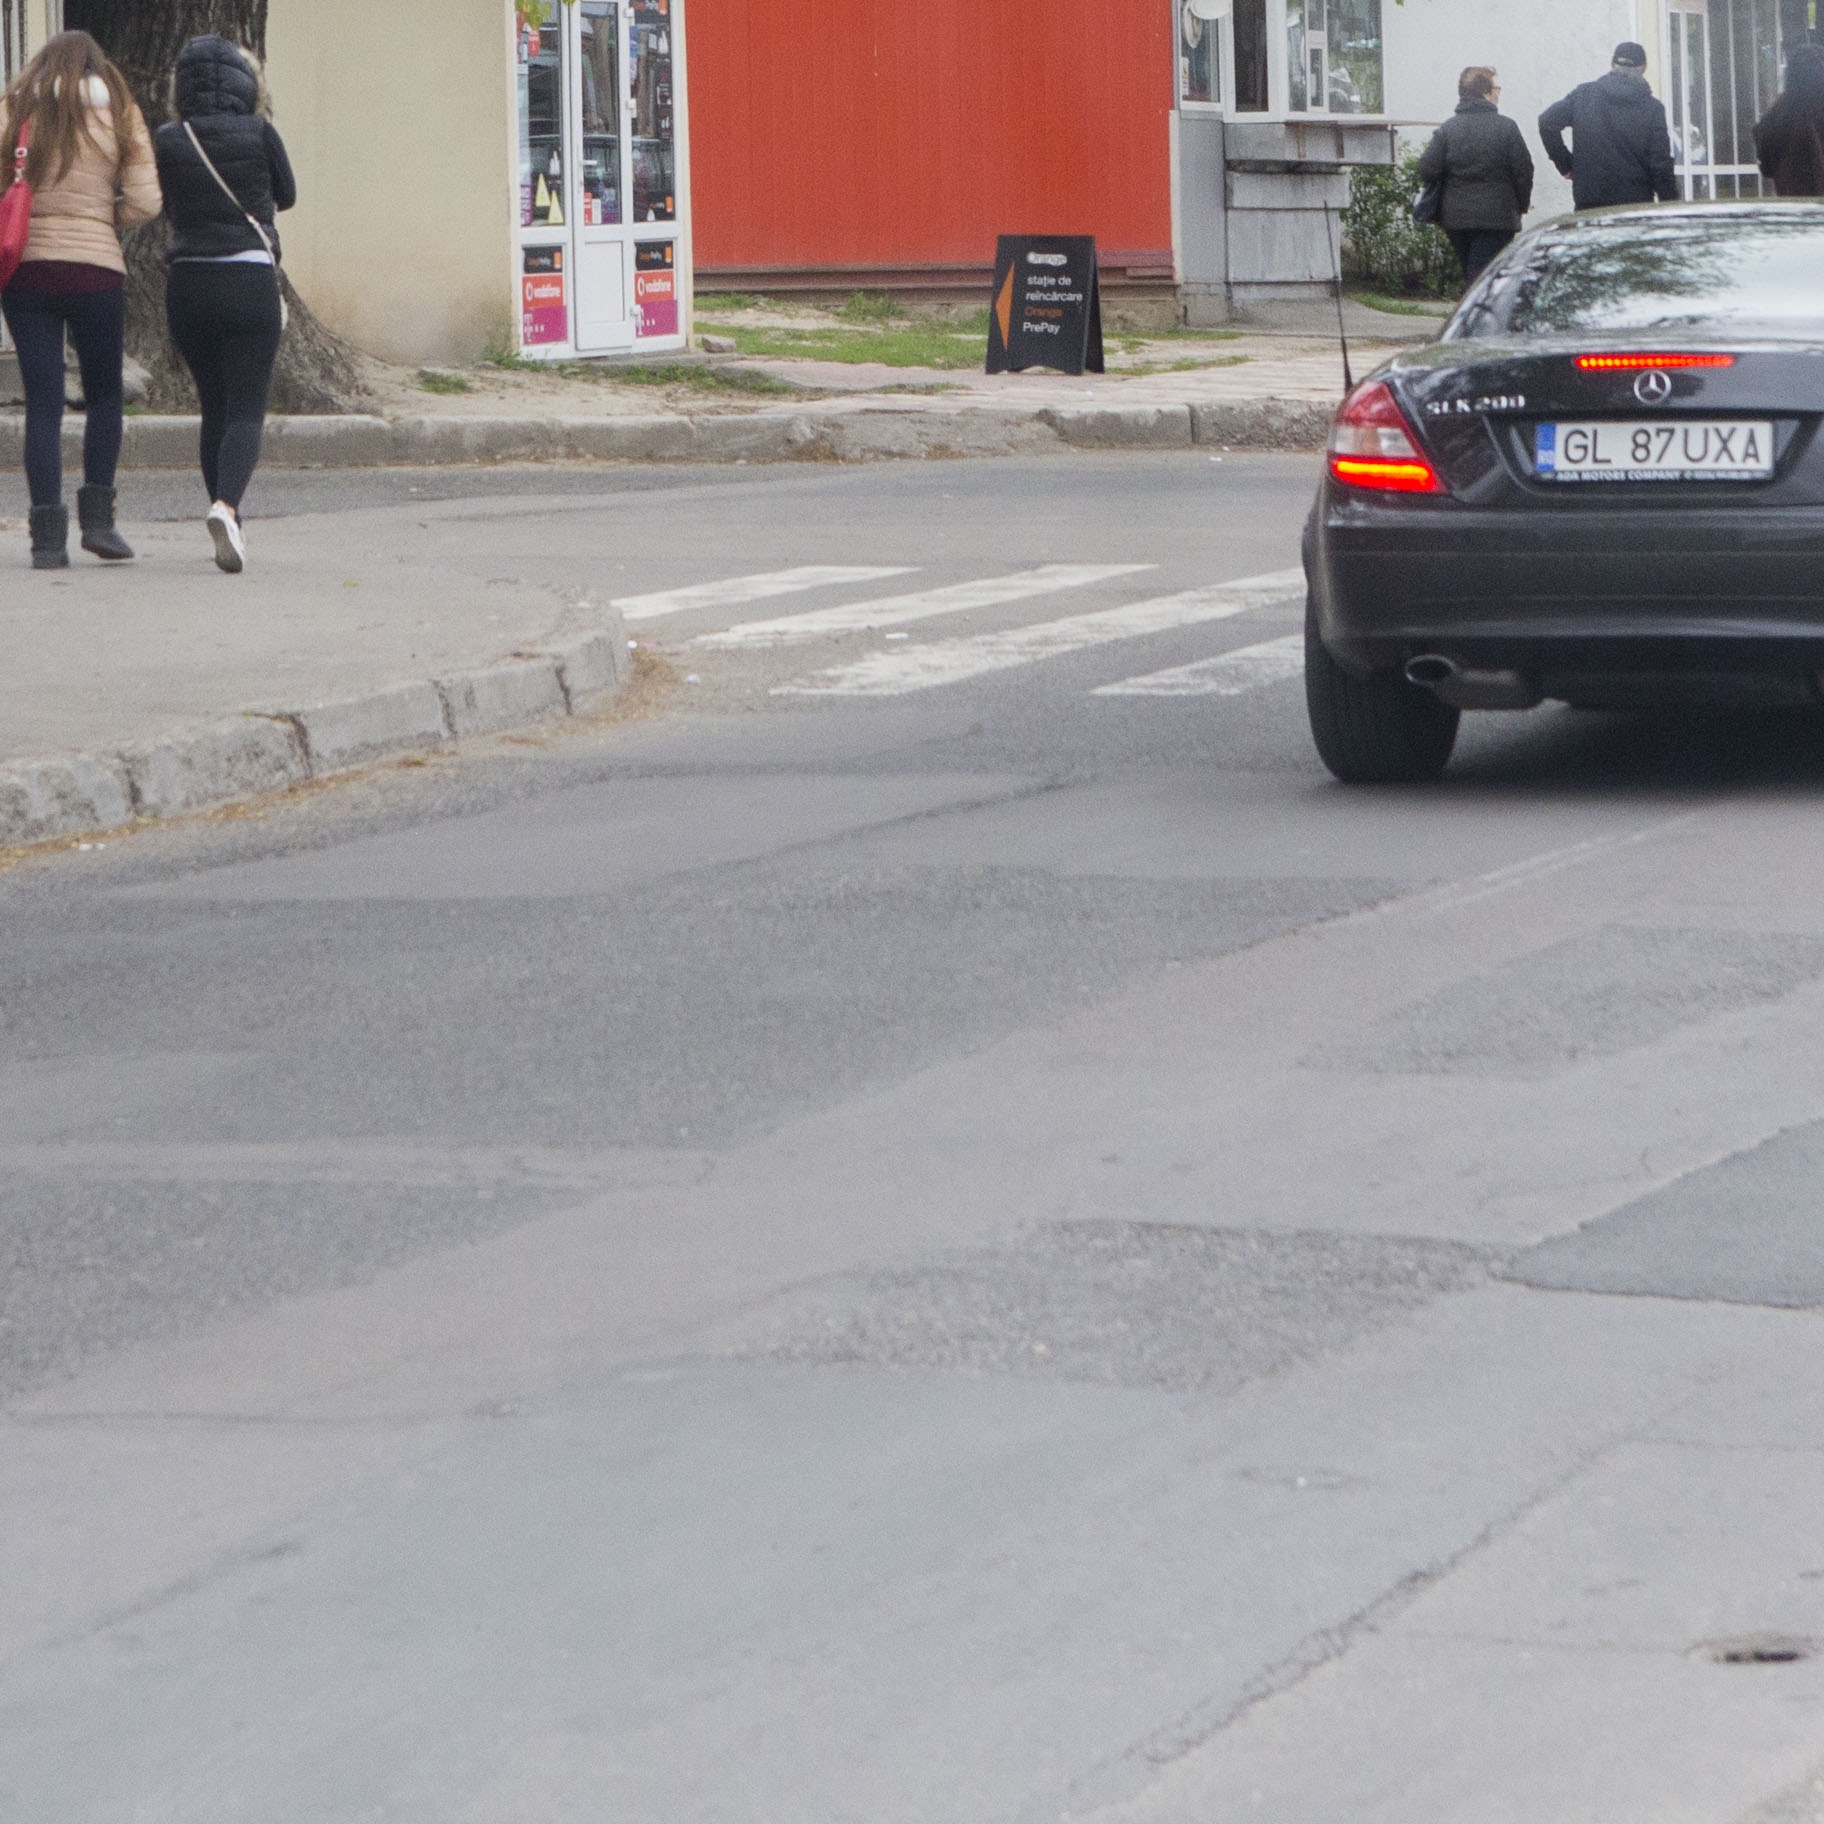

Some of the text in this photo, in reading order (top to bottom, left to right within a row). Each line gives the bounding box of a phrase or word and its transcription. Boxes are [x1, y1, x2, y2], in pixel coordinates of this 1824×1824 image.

[1058, 276, 1072, 286] de
[1023, 321, 1061, 335] PrePay
[1564, 427, 1761, 464] GL 87 UXA
